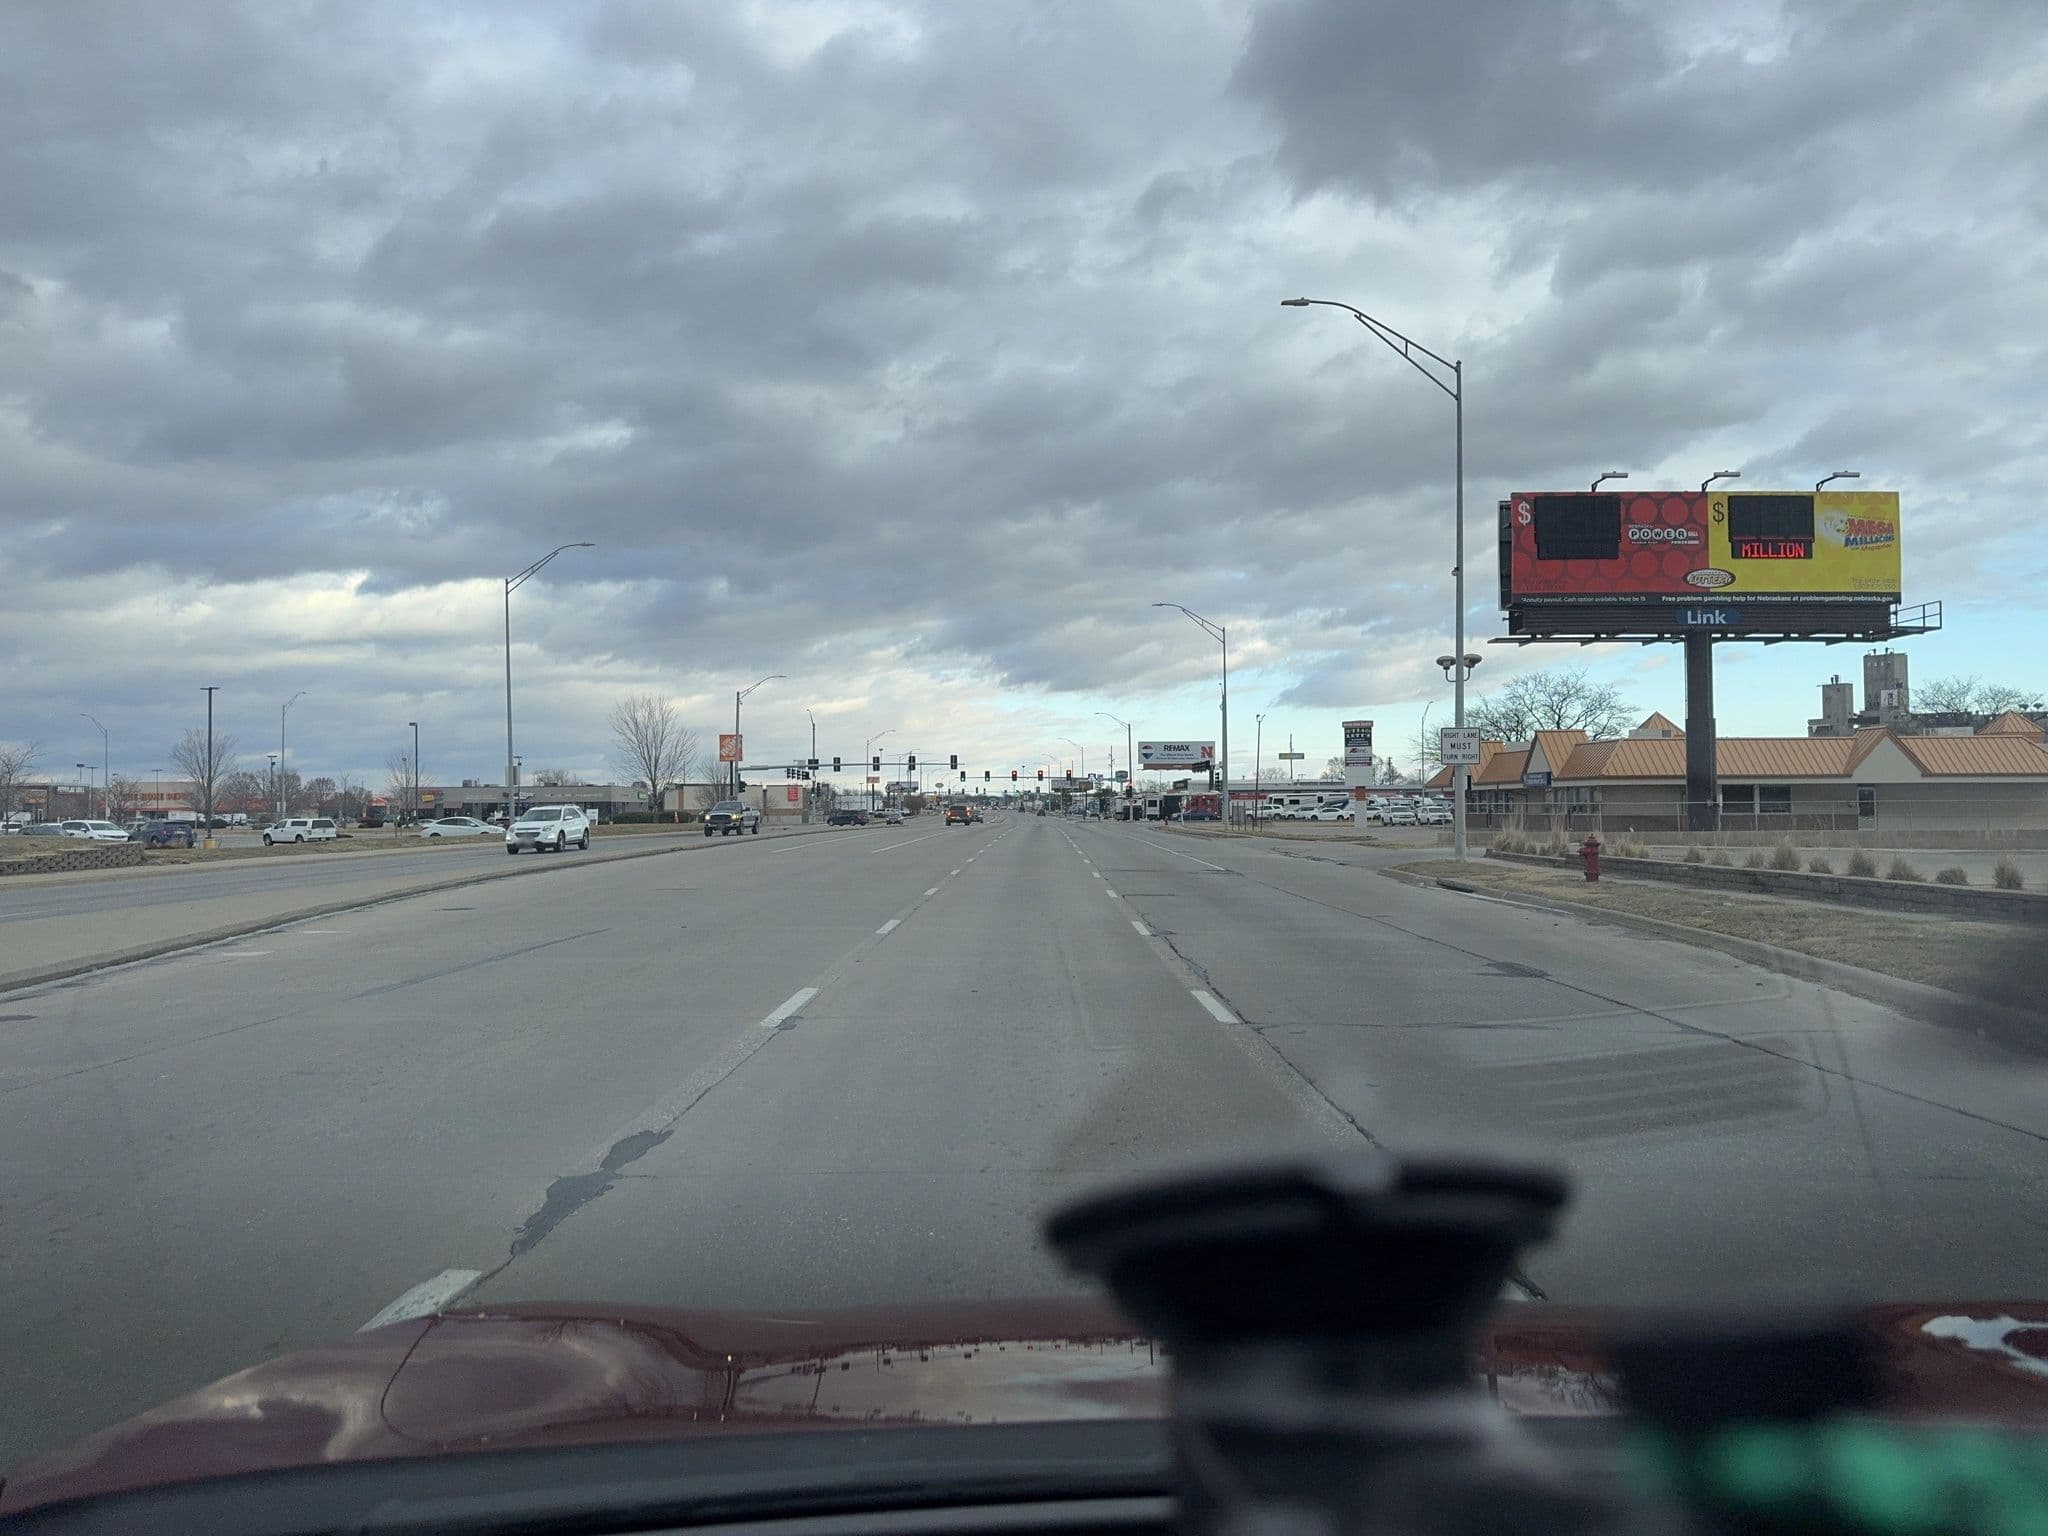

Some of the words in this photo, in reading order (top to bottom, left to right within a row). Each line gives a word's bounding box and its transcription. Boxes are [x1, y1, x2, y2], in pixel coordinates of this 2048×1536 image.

[1518, 501, 1531, 525] $
[1712, 500, 1725, 525] $
[1628, 528, 1688, 540] POWER
[1741, 542, 1805, 558] MILLION
[1677, 595, 1703, 603] problem
[1703, 595, 1731, 603] gambling
[1732, 595, 1746, 603] help
[1687, 609, 1727, 624] Link
